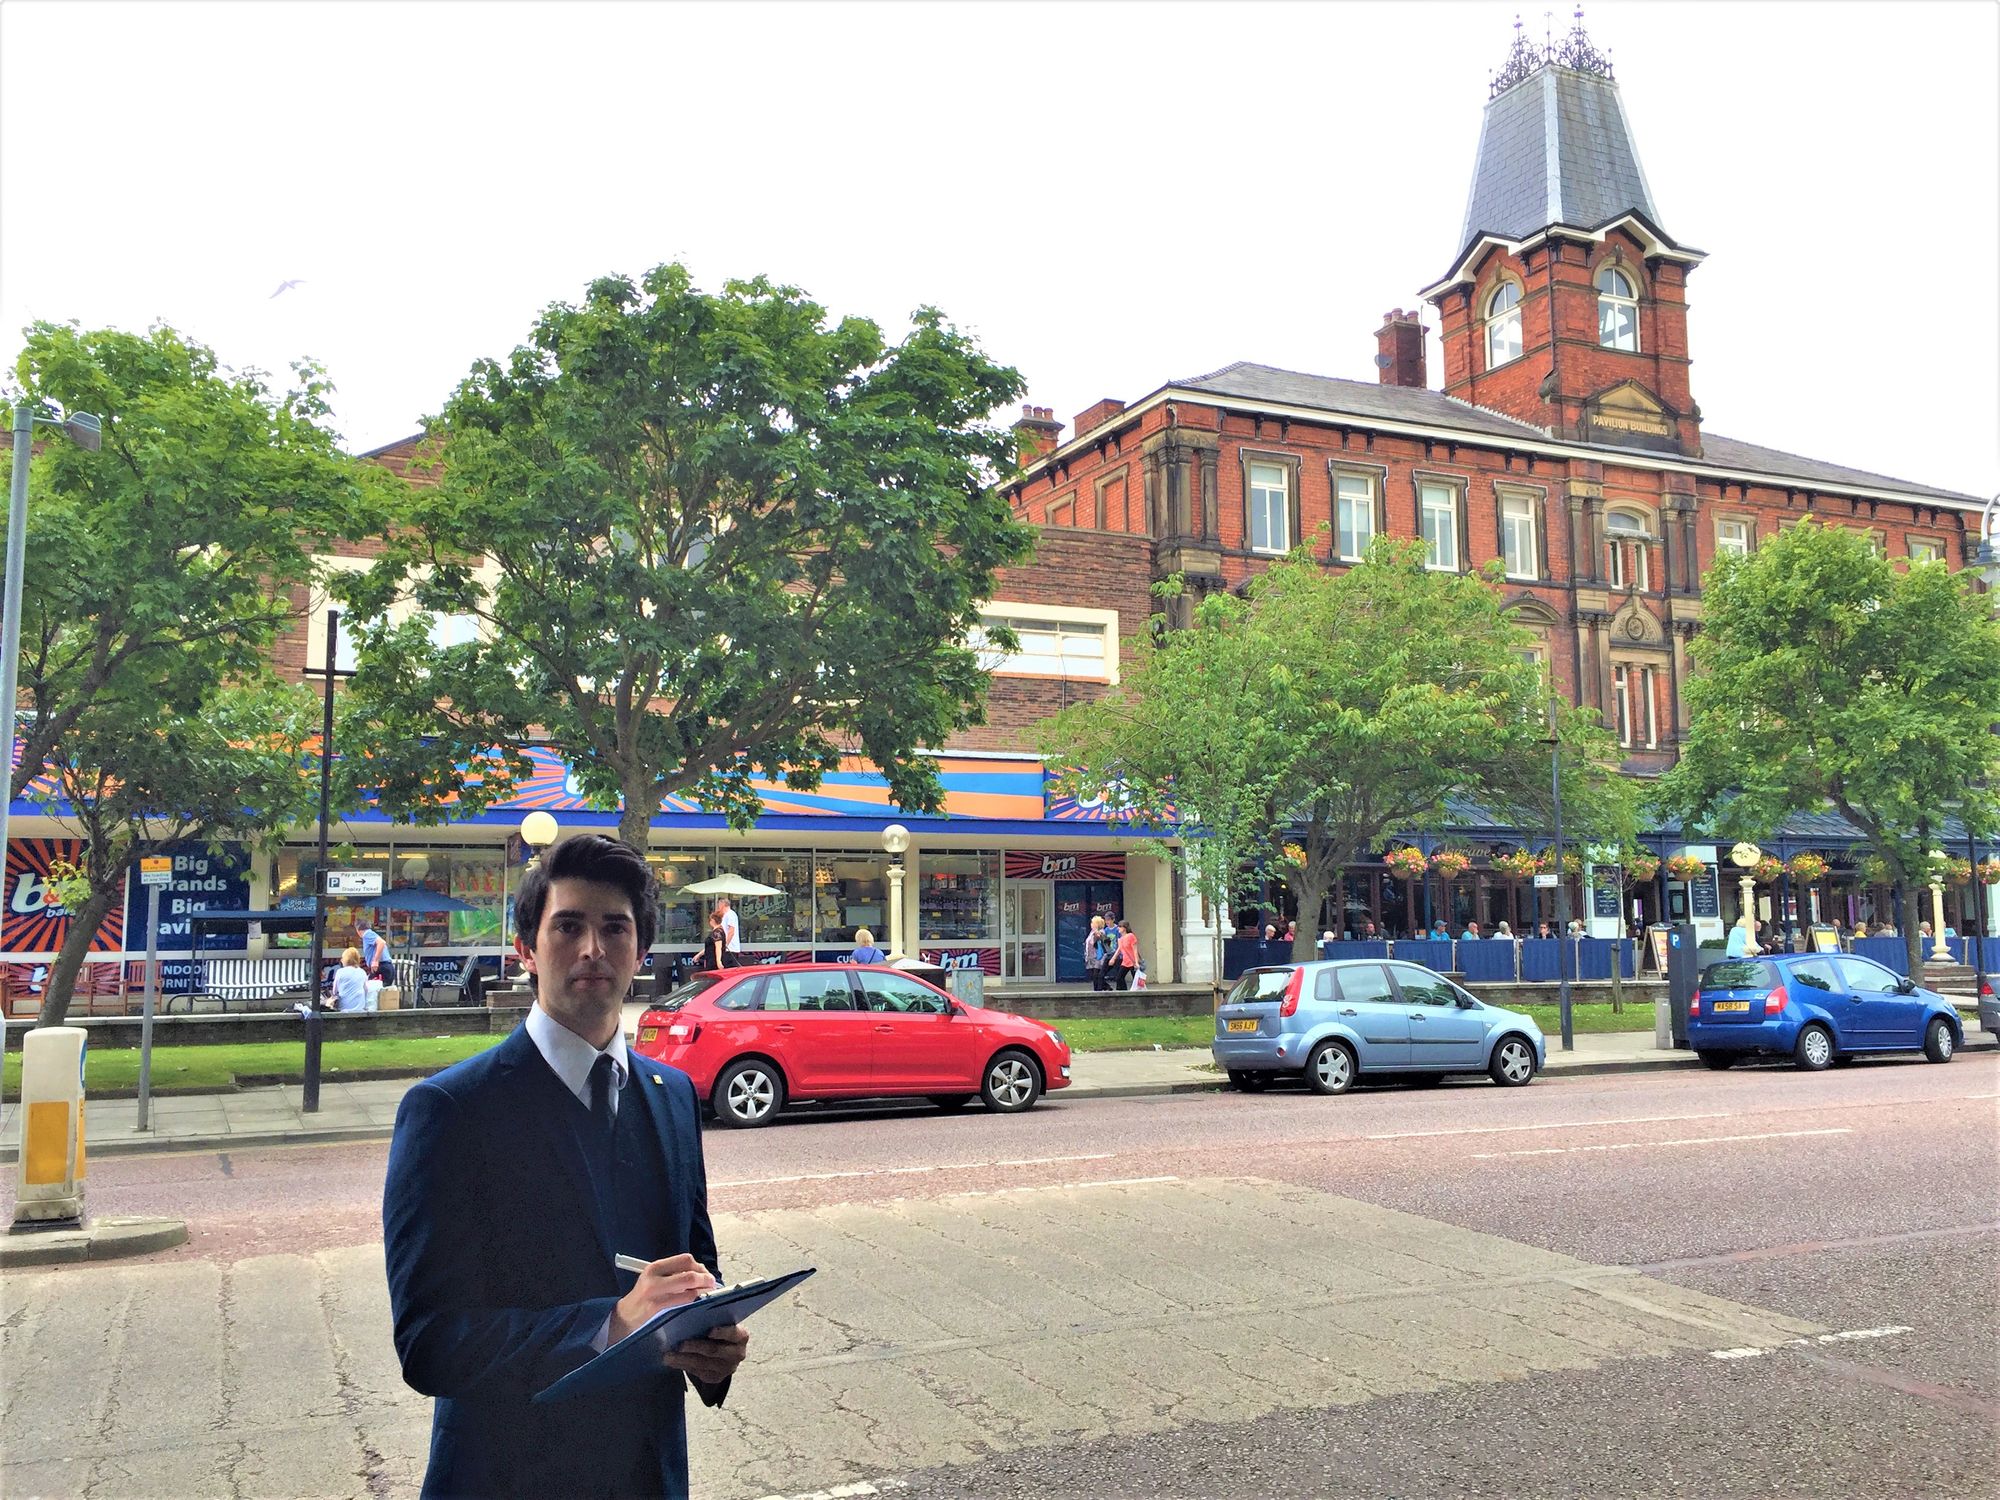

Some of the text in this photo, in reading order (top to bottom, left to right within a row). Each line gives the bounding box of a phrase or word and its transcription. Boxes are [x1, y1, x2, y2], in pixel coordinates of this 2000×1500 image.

[1593, 414, 1668, 436] PAVILION BUILDINGS
[175, 856, 208, 875] Big
